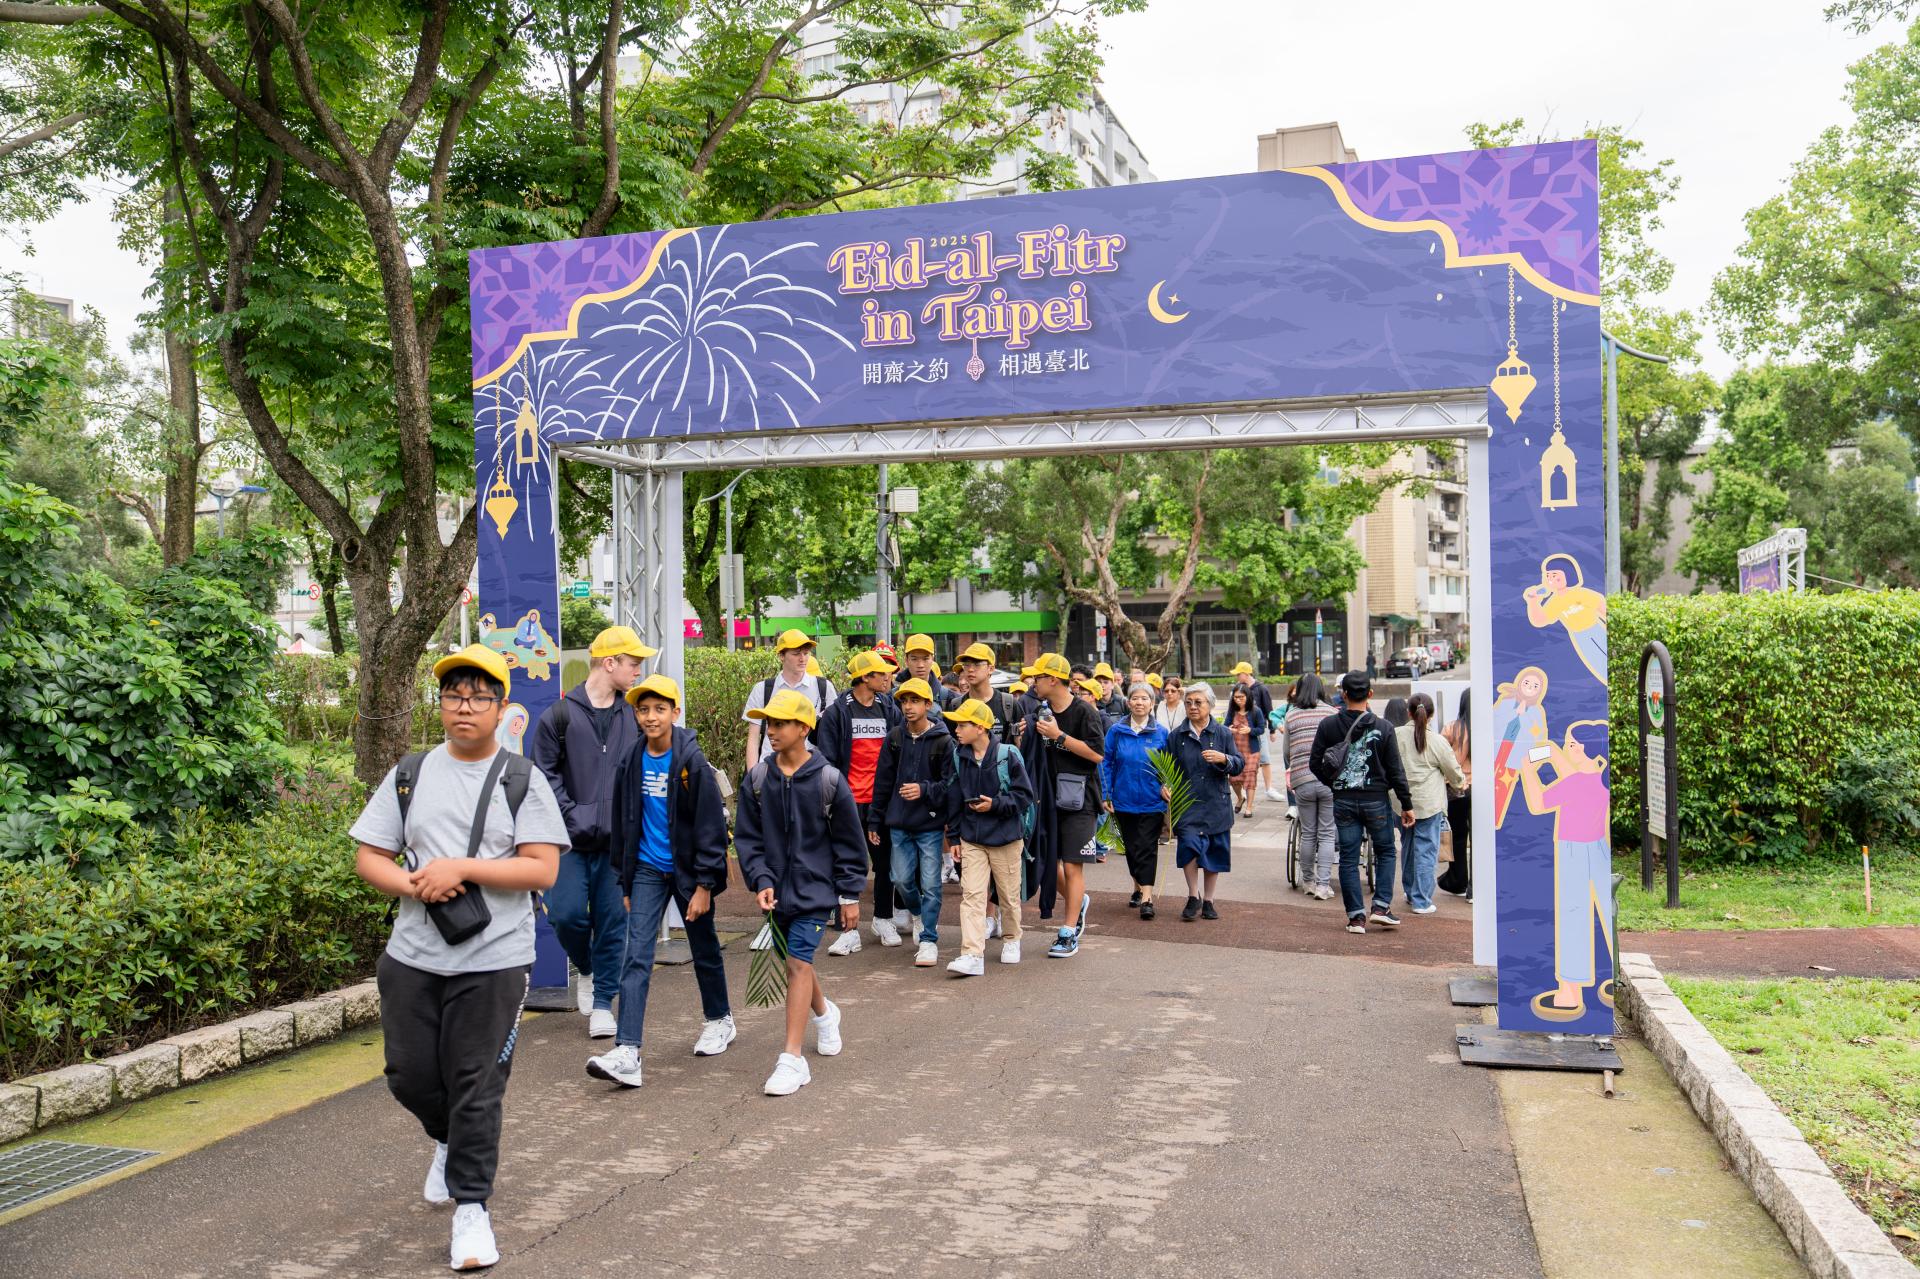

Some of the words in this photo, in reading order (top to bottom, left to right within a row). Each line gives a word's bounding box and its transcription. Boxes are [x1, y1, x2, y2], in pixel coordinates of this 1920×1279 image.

[828, 224, 1126, 294] Eid-al-Fitr
[930, 235, 967, 247] 2025
[861, 299, 915, 347] in
[922, 281, 1092, 348] Taipei
[863, 358, 949, 385] 開齋之約
[999, 348, 1090, 376] 相遇臺北
[852, 724, 881, 734] didas
